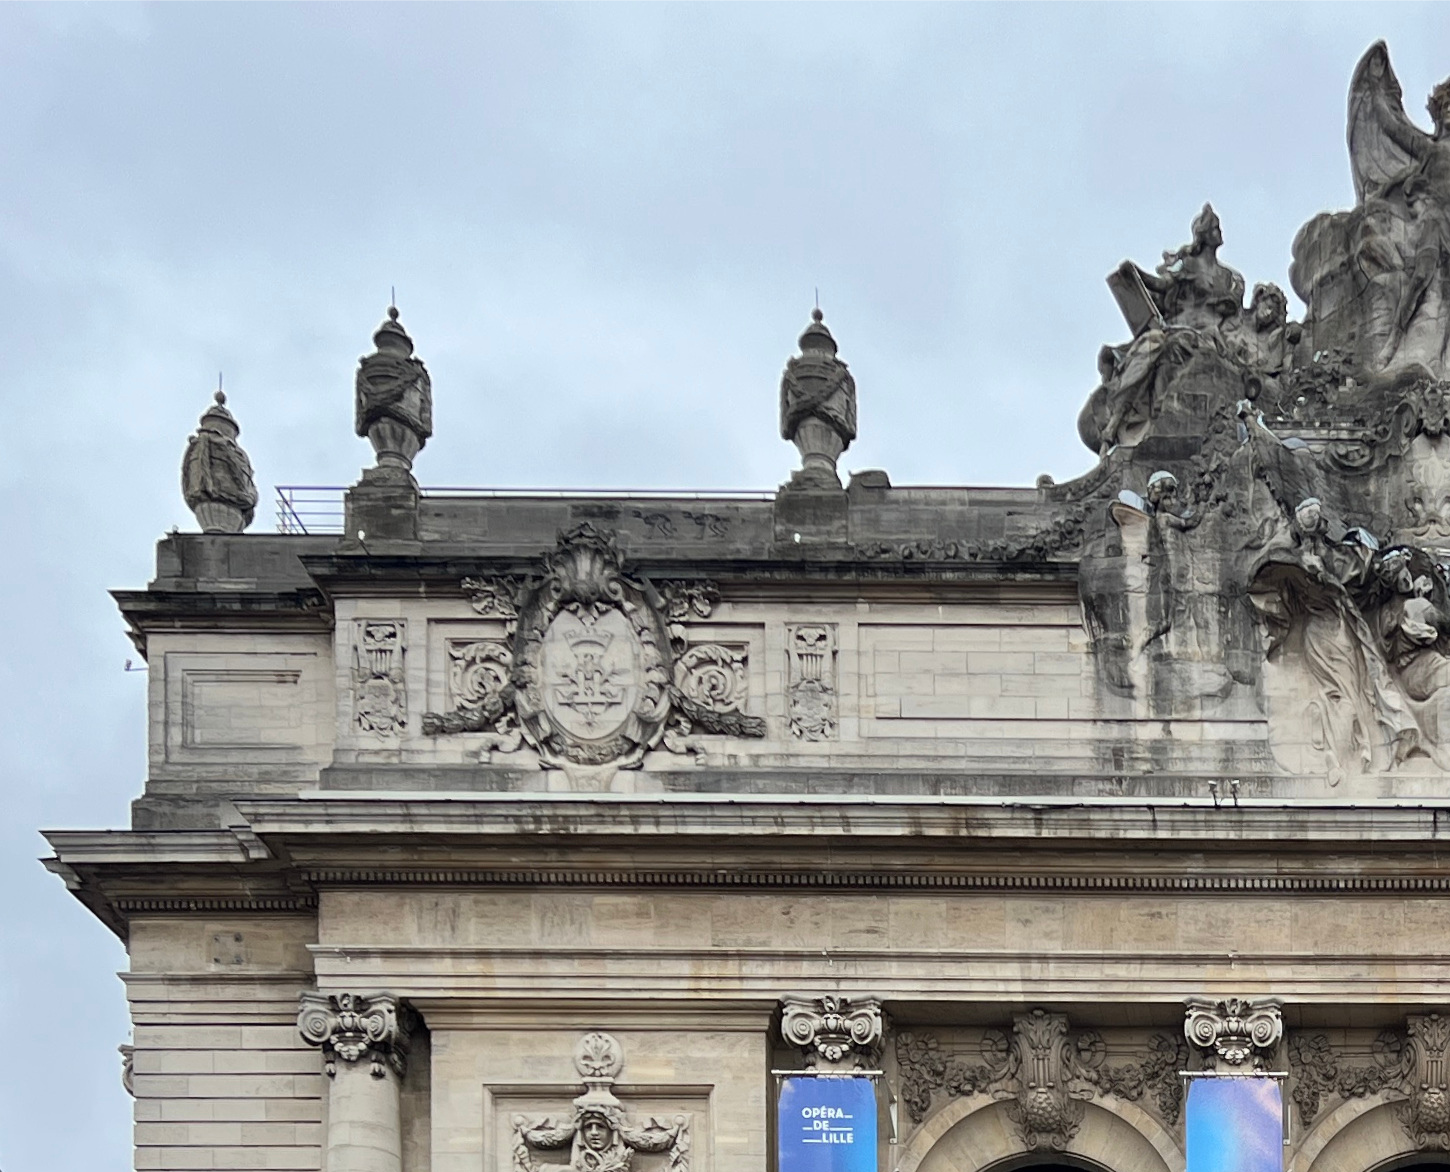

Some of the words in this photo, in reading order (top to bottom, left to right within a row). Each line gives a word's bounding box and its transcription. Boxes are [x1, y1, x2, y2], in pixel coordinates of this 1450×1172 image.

[802, 1106, 844, 1118] OPÉRA
[813, 1120, 830, 1130] DE
[822, 1133, 854, 1143] LILLE
